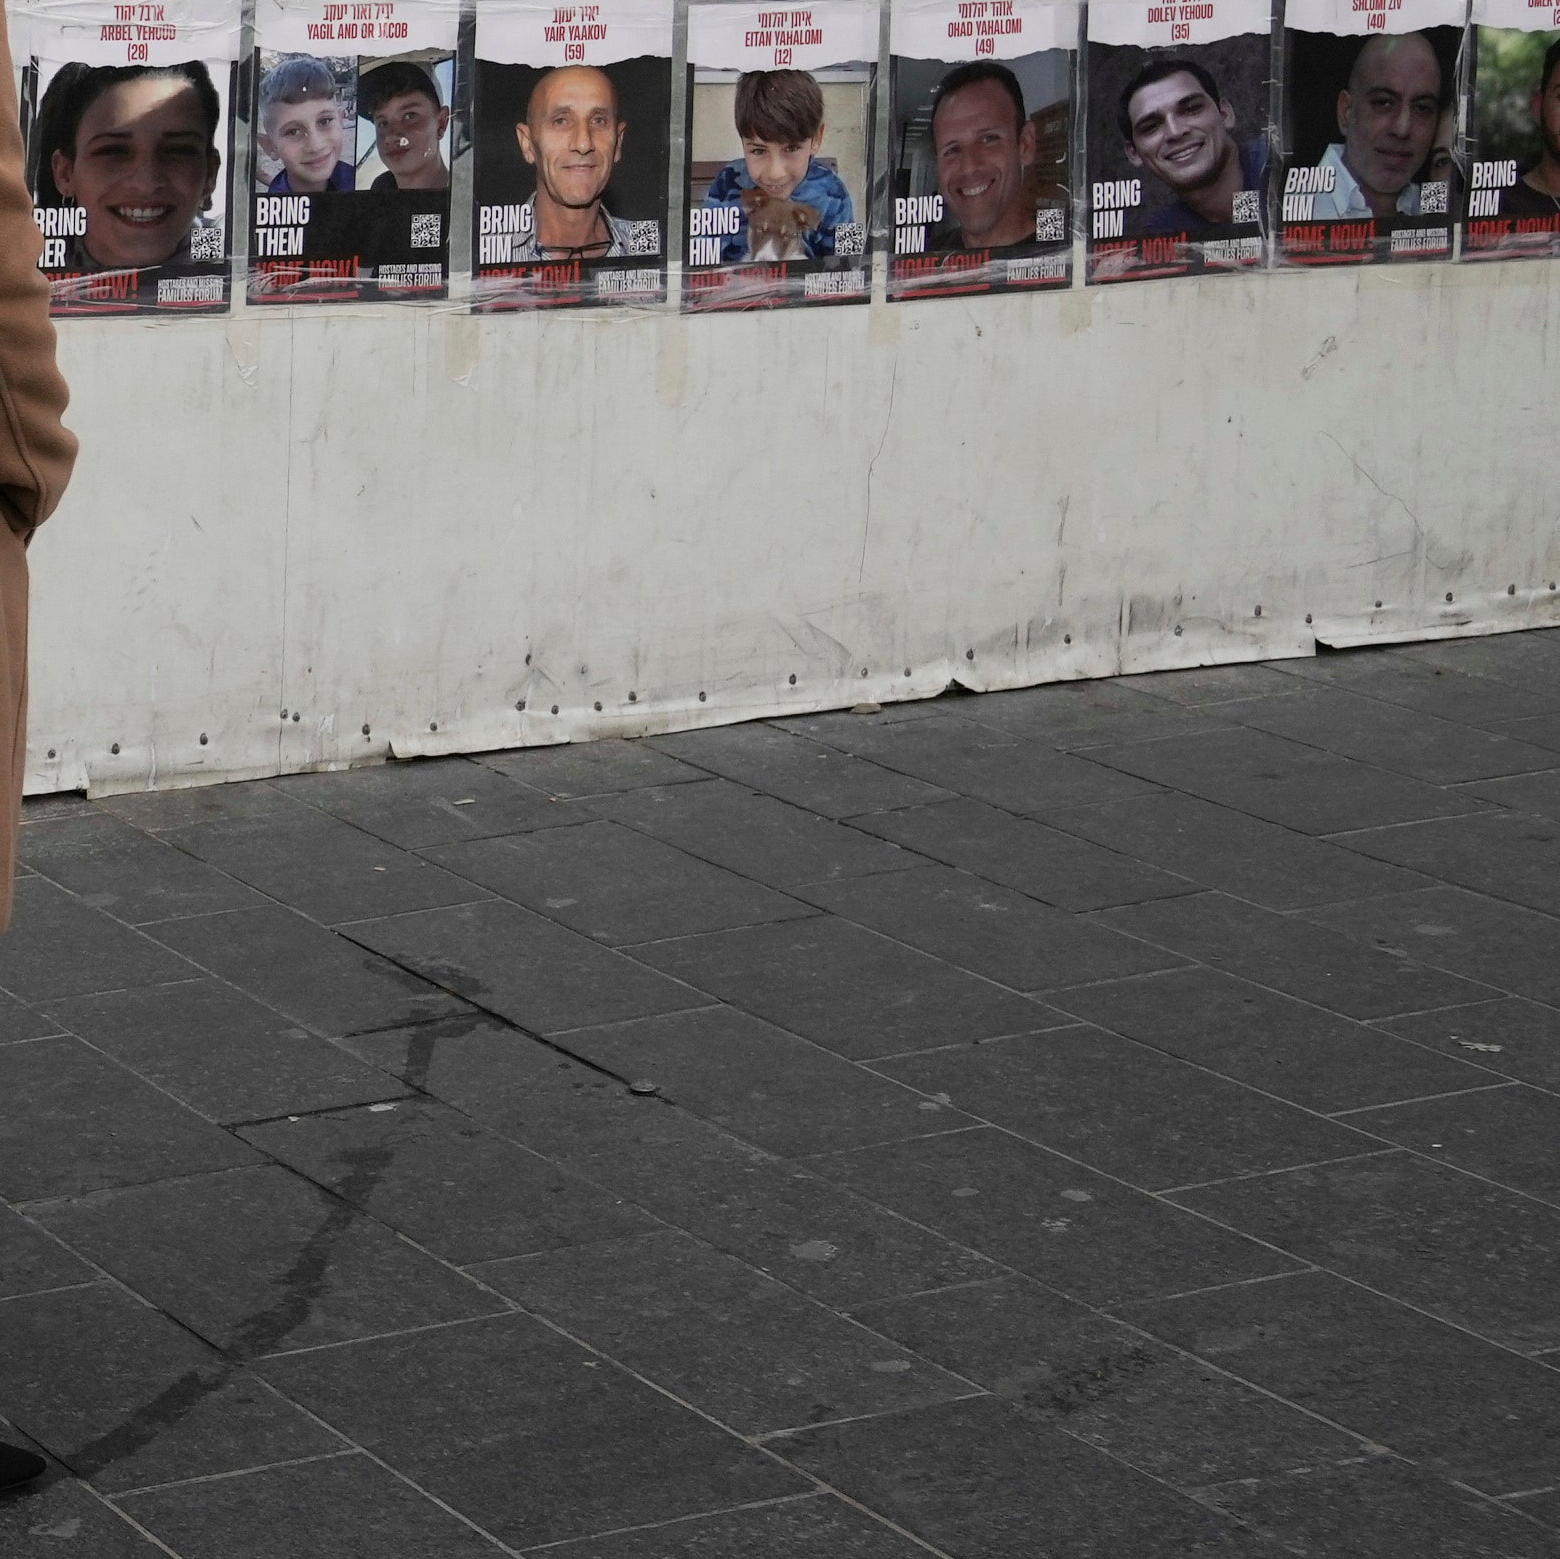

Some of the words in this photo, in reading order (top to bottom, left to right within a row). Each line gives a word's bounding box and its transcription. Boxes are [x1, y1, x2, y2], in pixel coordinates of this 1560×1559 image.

[958, 1, 989, 19] יהלומי
[992, 0, 1014, 16] אוהד
[1147, 6, 1178, 24] DOLEV
[1179, 3, 1215, 21] YEHOUD
[100, 23, 135, 42] ARBEL
[136, 24, 177, 41] YEHOUD
[307, 23, 335, 40] YAGIL
[338, 21, 360, 39] AND
[361, 22, 375, 39] OR
[545, 24, 566, 42] YAIR
[569, 24, 608, 43] YAAKOV
[948, 20, 974, 38] OHAD
[976, 17, 1023, 35] YAHALOMI
[745, 30, 774, 47] EITAN
[774, 28, 824, 46] YAHALOMI
[775, 48, 793, 65] (12)
[1092, 178, 1142, 210] BRING
[1092, 210, 1124, 240] HIM
